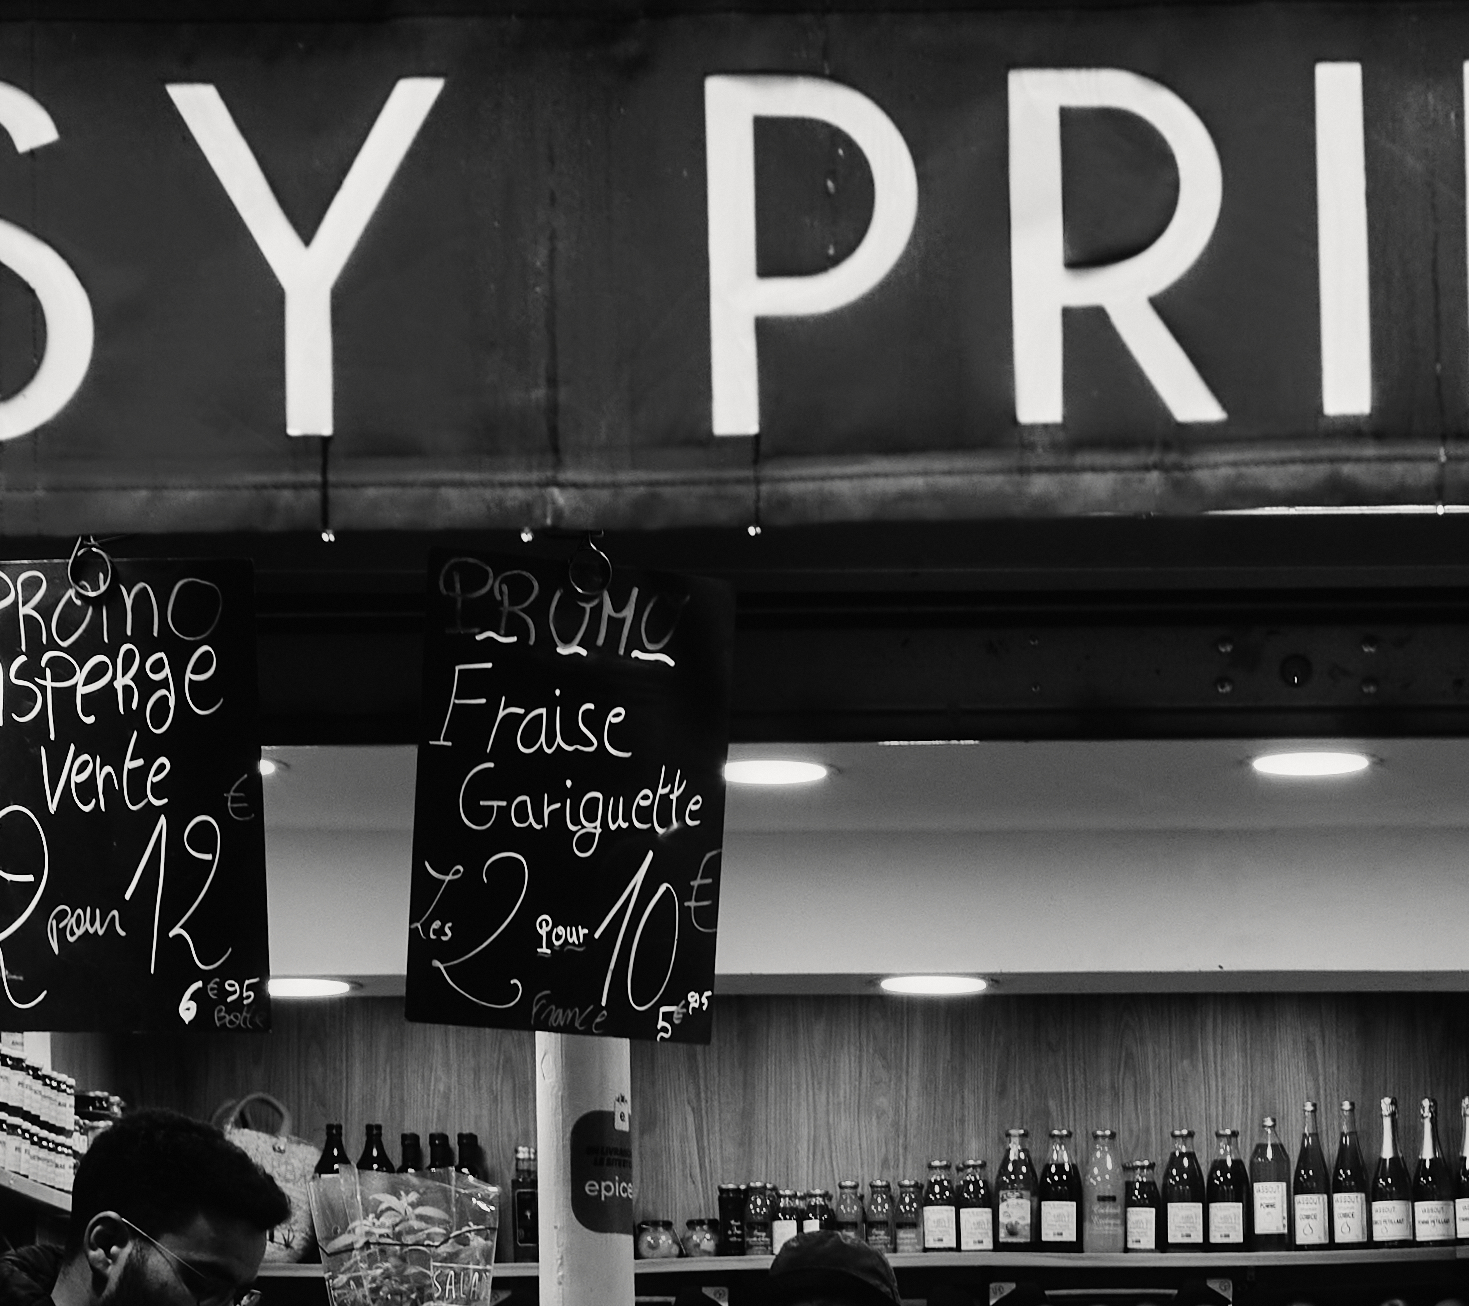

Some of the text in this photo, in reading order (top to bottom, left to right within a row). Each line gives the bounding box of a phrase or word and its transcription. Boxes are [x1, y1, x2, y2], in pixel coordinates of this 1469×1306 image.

[428, 662, 634, 758] Fraise
[457, 760, 704, 858] Gariguette
[431, 850, 530, 1009] 2
